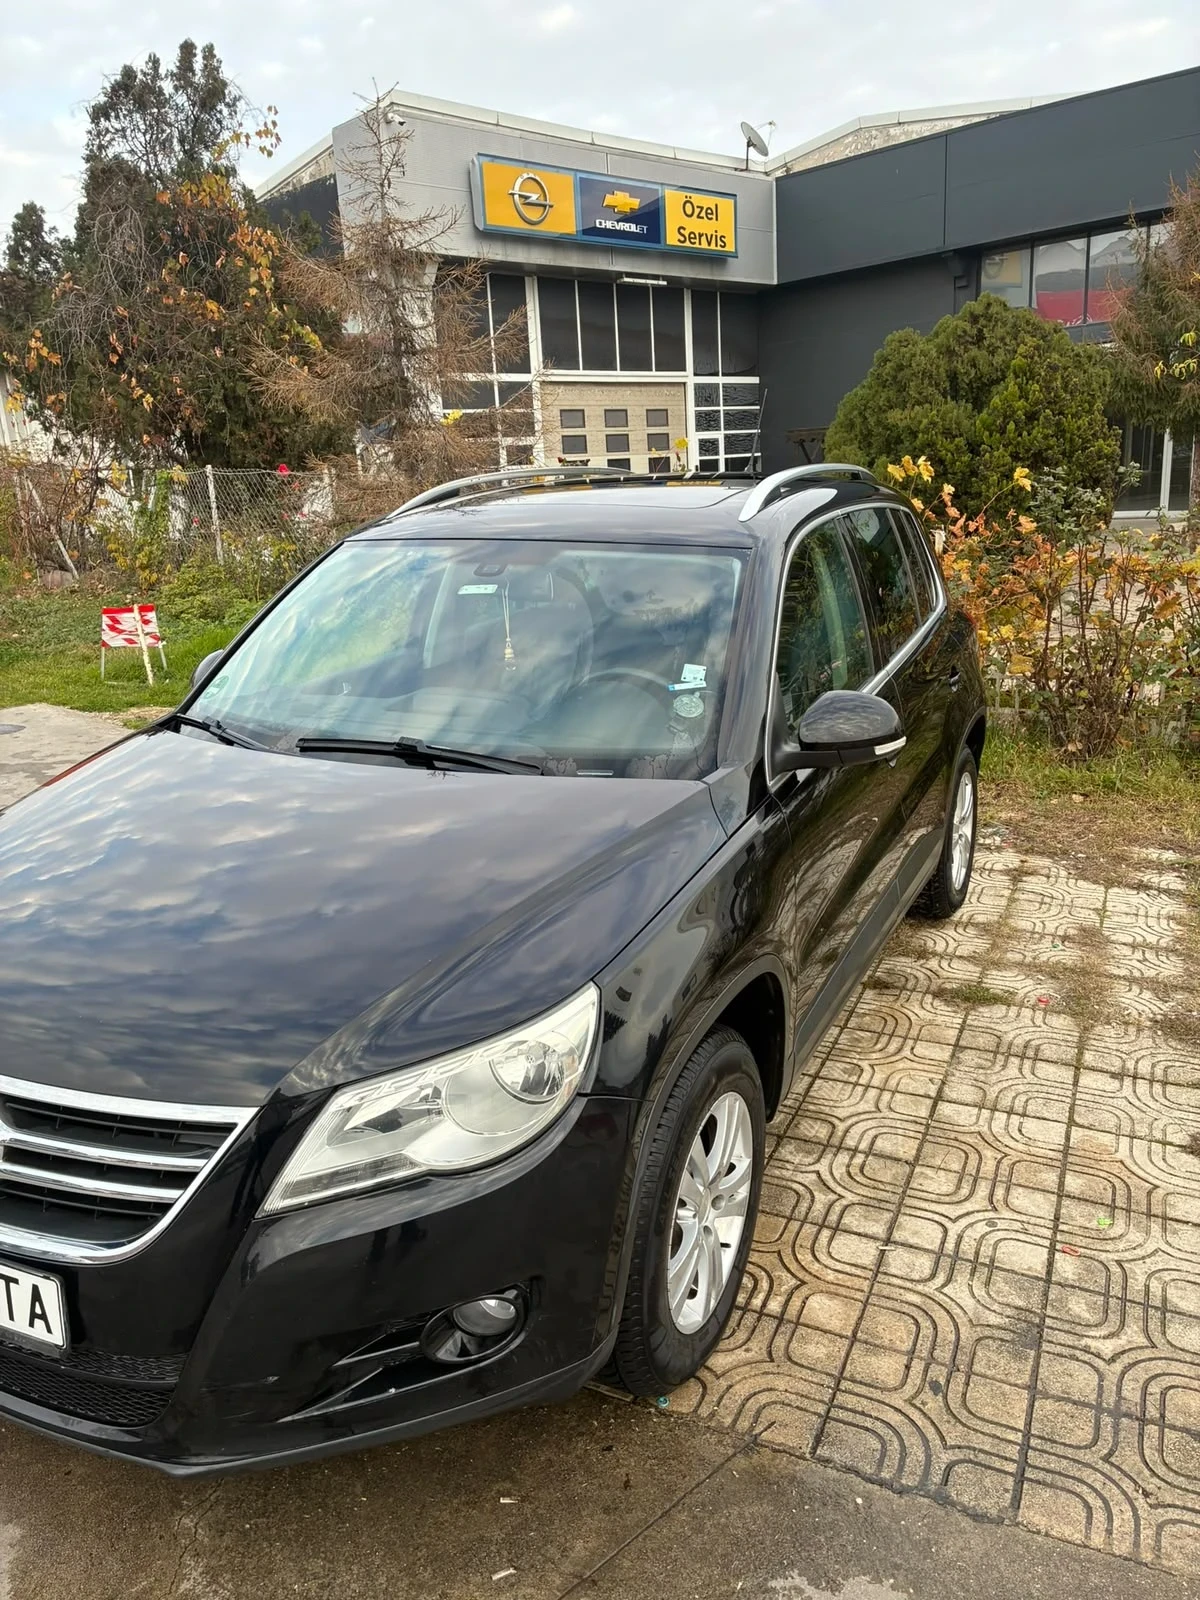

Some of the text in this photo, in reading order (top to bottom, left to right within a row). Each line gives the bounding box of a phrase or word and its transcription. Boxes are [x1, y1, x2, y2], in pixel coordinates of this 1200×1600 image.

[682, 195, 719, 222] Özel
[595, 219, 648, 234] CHEVROLET
[677, 226, 727, 249] Servis
